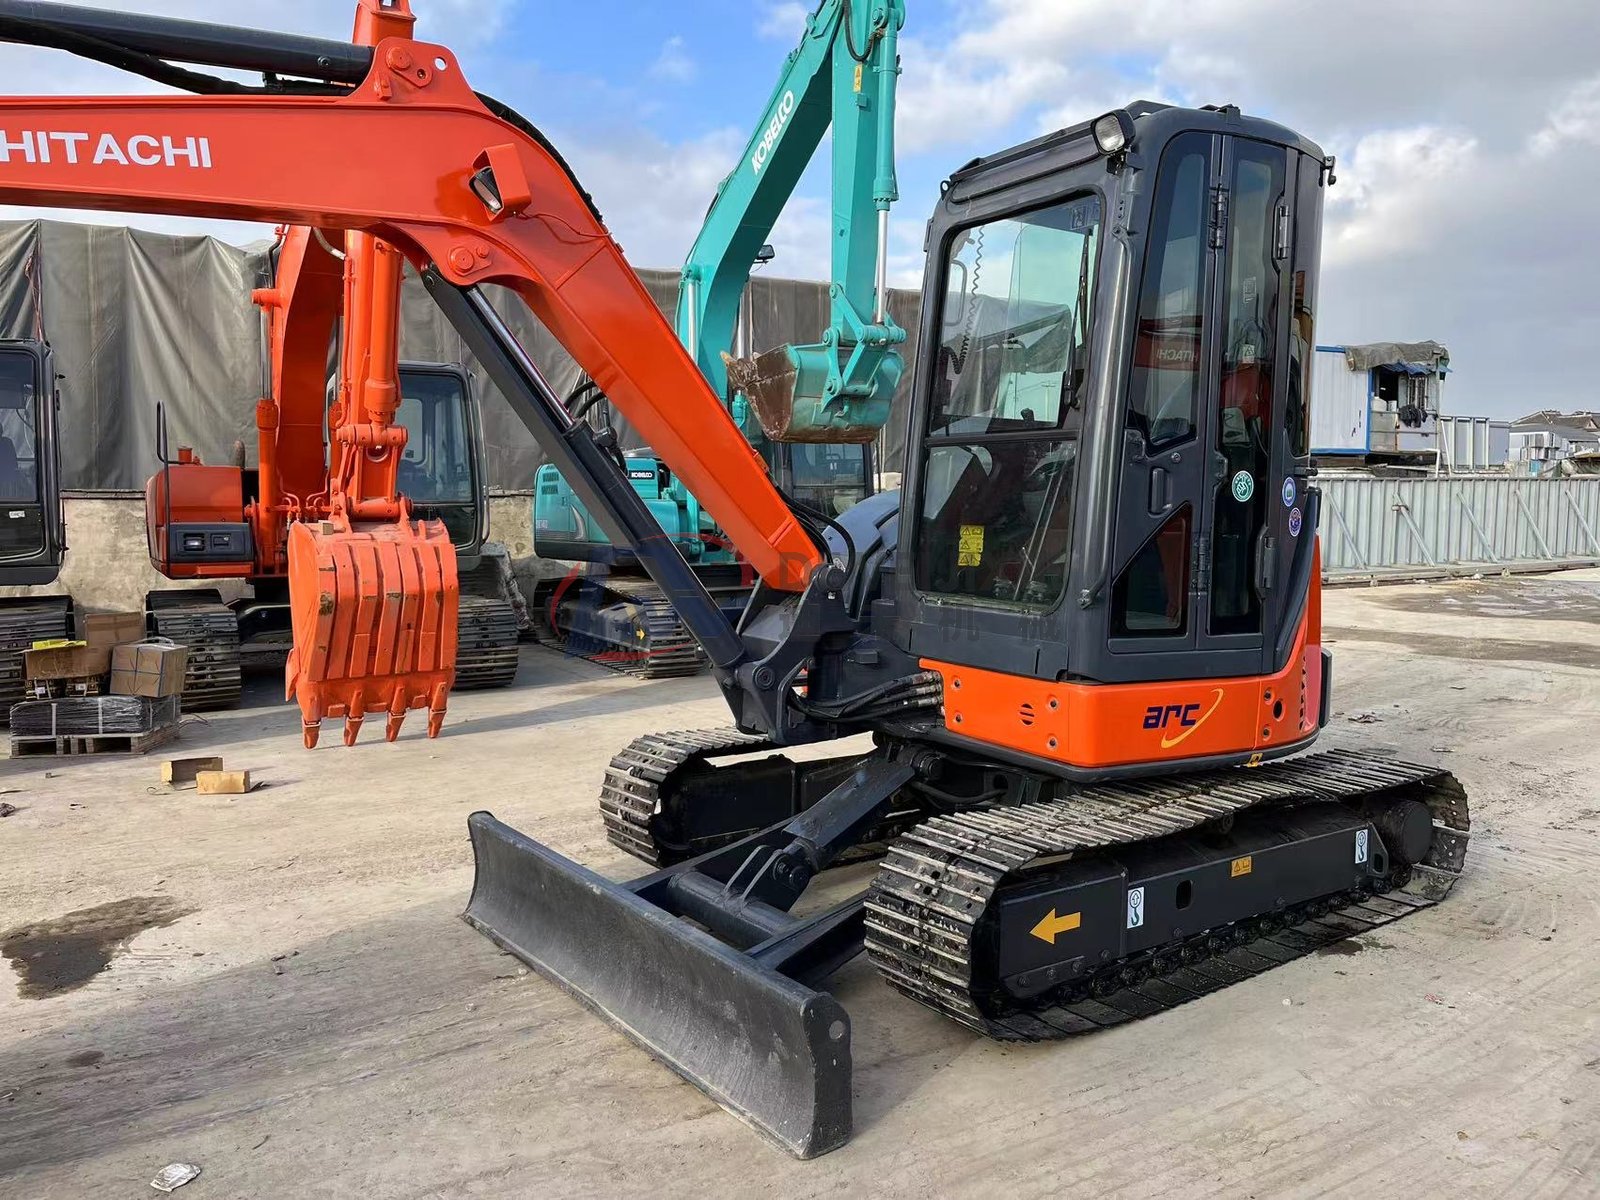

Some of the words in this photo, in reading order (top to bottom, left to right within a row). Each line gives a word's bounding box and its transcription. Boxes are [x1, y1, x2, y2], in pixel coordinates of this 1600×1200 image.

[0, 130, 212, 168] HITACHI
[751, 90, 794, 176] KOBELCO
[1143, 703, 1201, 729] arc
